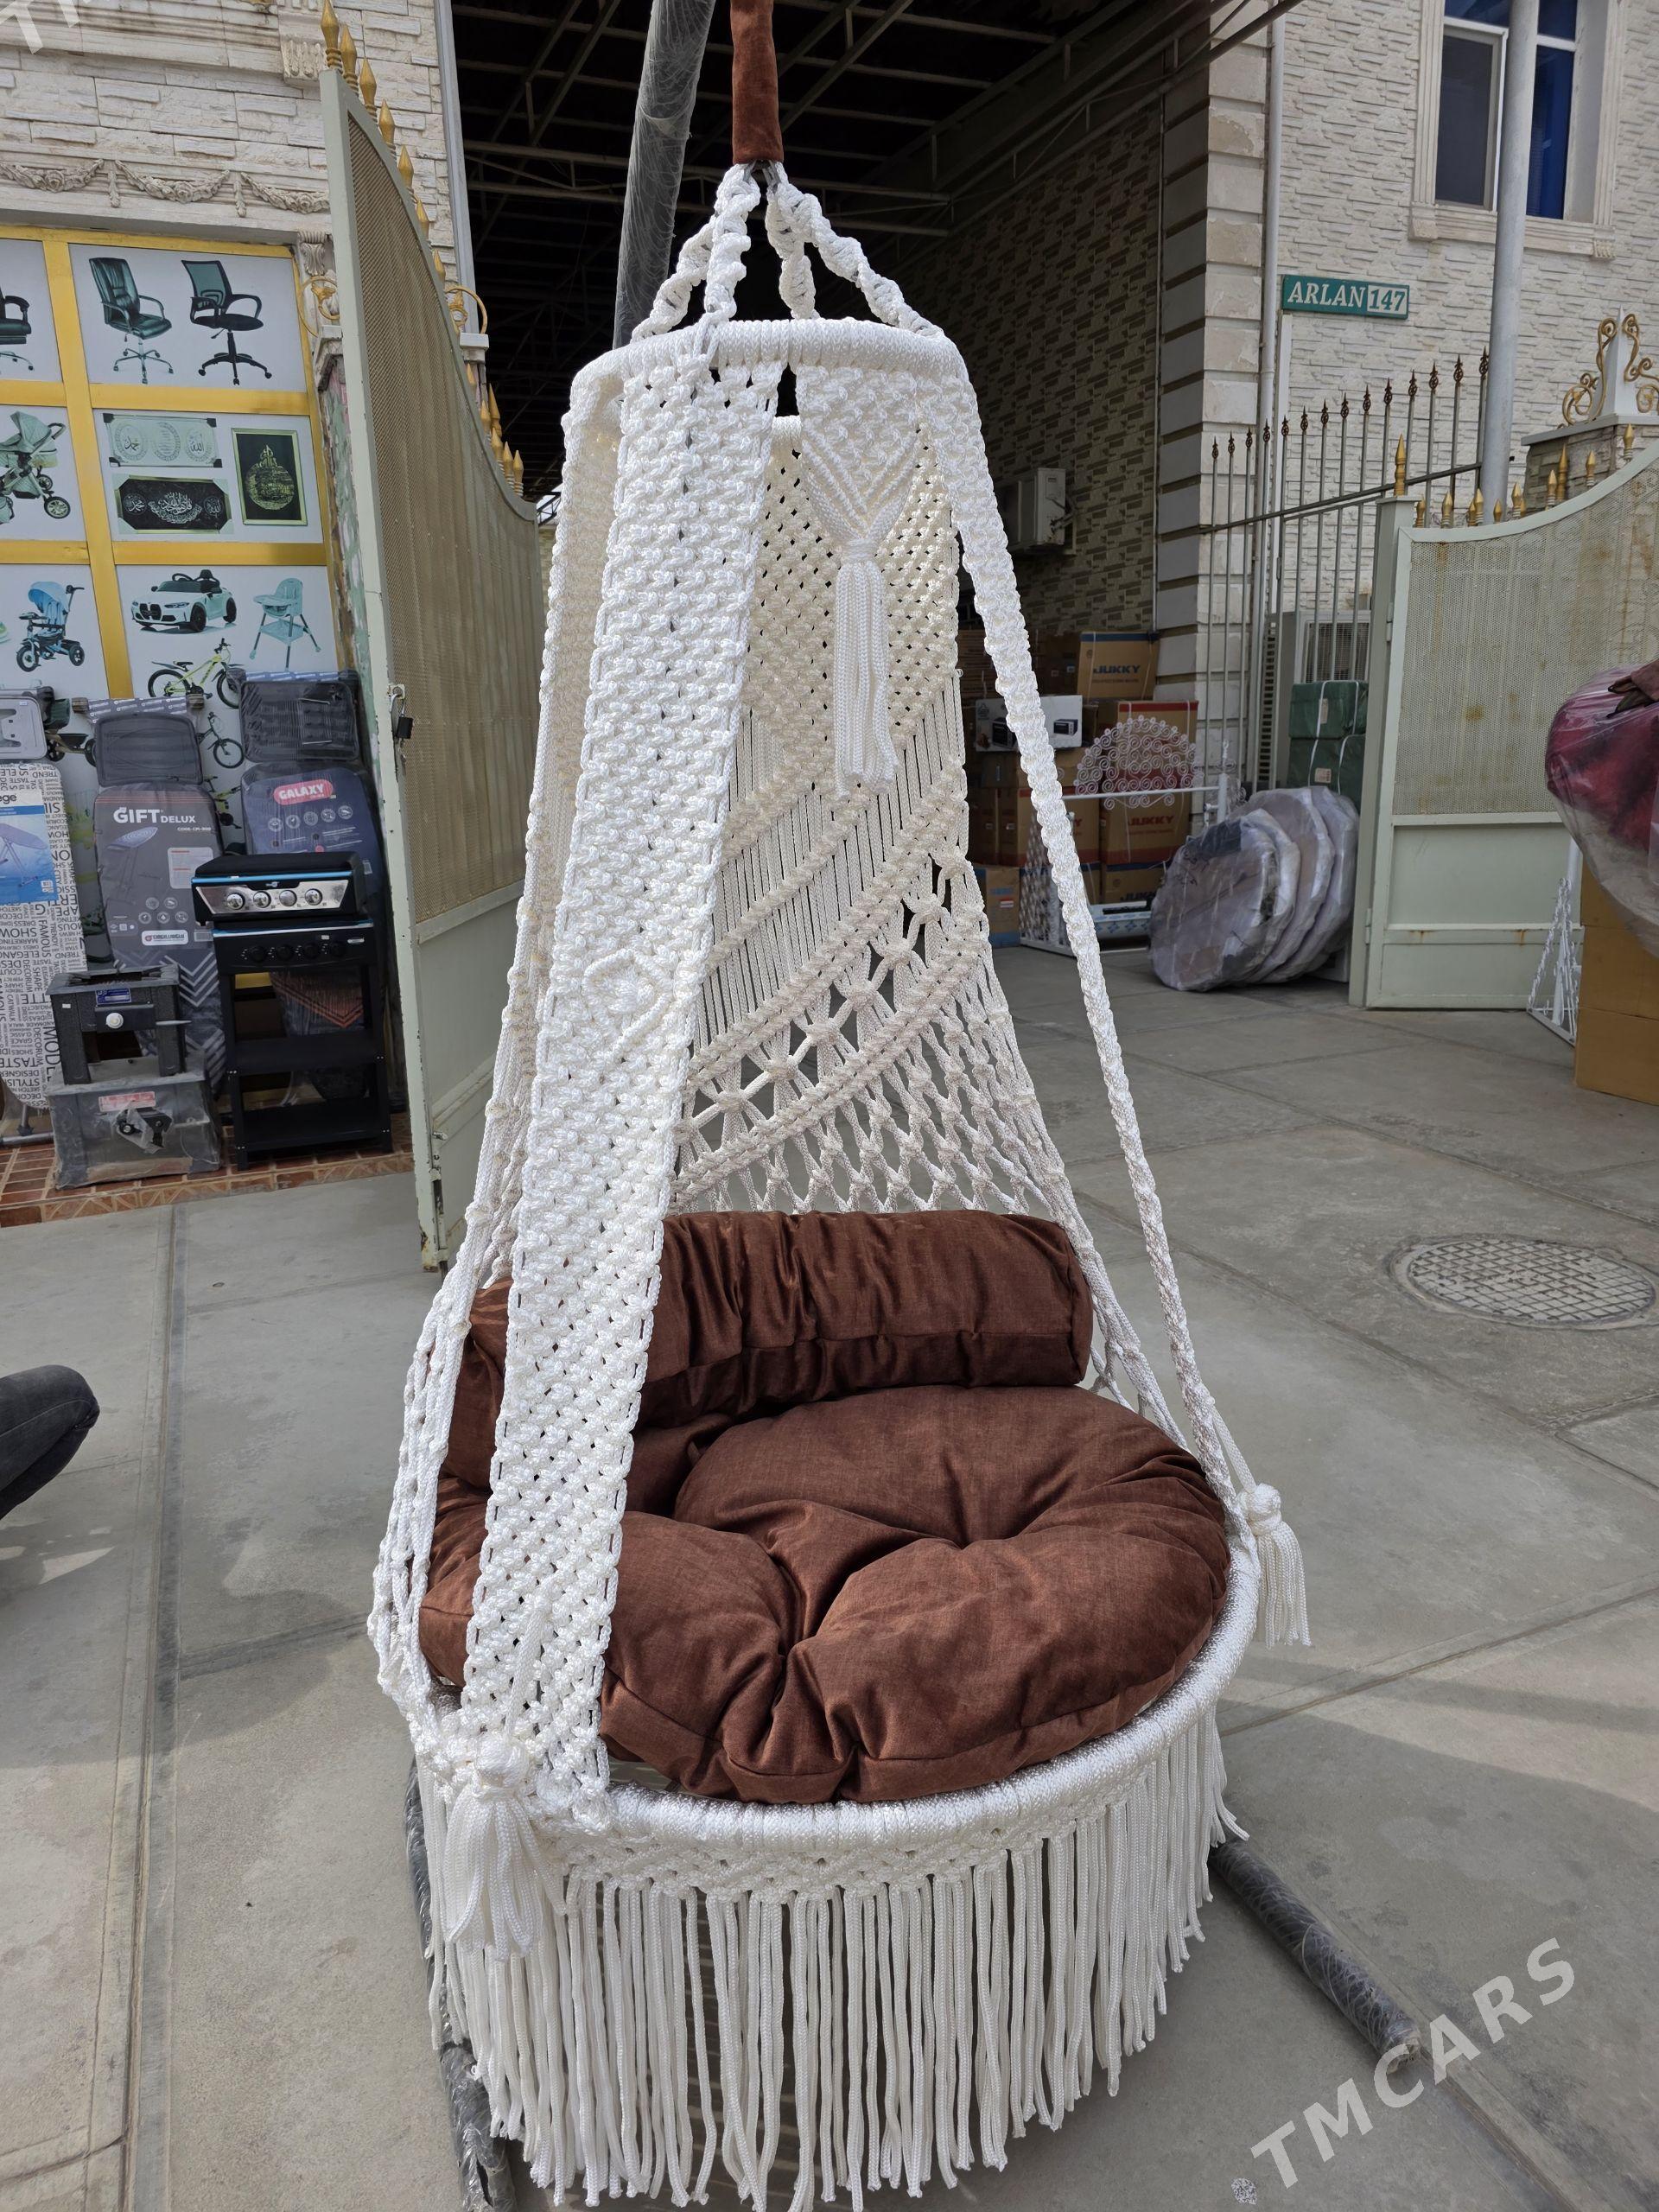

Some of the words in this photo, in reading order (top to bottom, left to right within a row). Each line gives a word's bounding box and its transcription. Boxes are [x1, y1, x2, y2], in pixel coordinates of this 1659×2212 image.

[1287, 281, 1366, 308] ARLAN
[1369, 289, 1406, 311] 147
[0, 794, 16, 804] ge
[278, 784, 324, 799] GALAXY
[113, 807, 161, 823] GIFT
[39, 919, 51, 957] FAMOUS
[22, 959, 33, 993] DECORUM
[33, 967, 42, 992] SHAPE
[34, 1027, 43, 1065] DECORUM
[0, 1057, 38, 1068] TASTE
